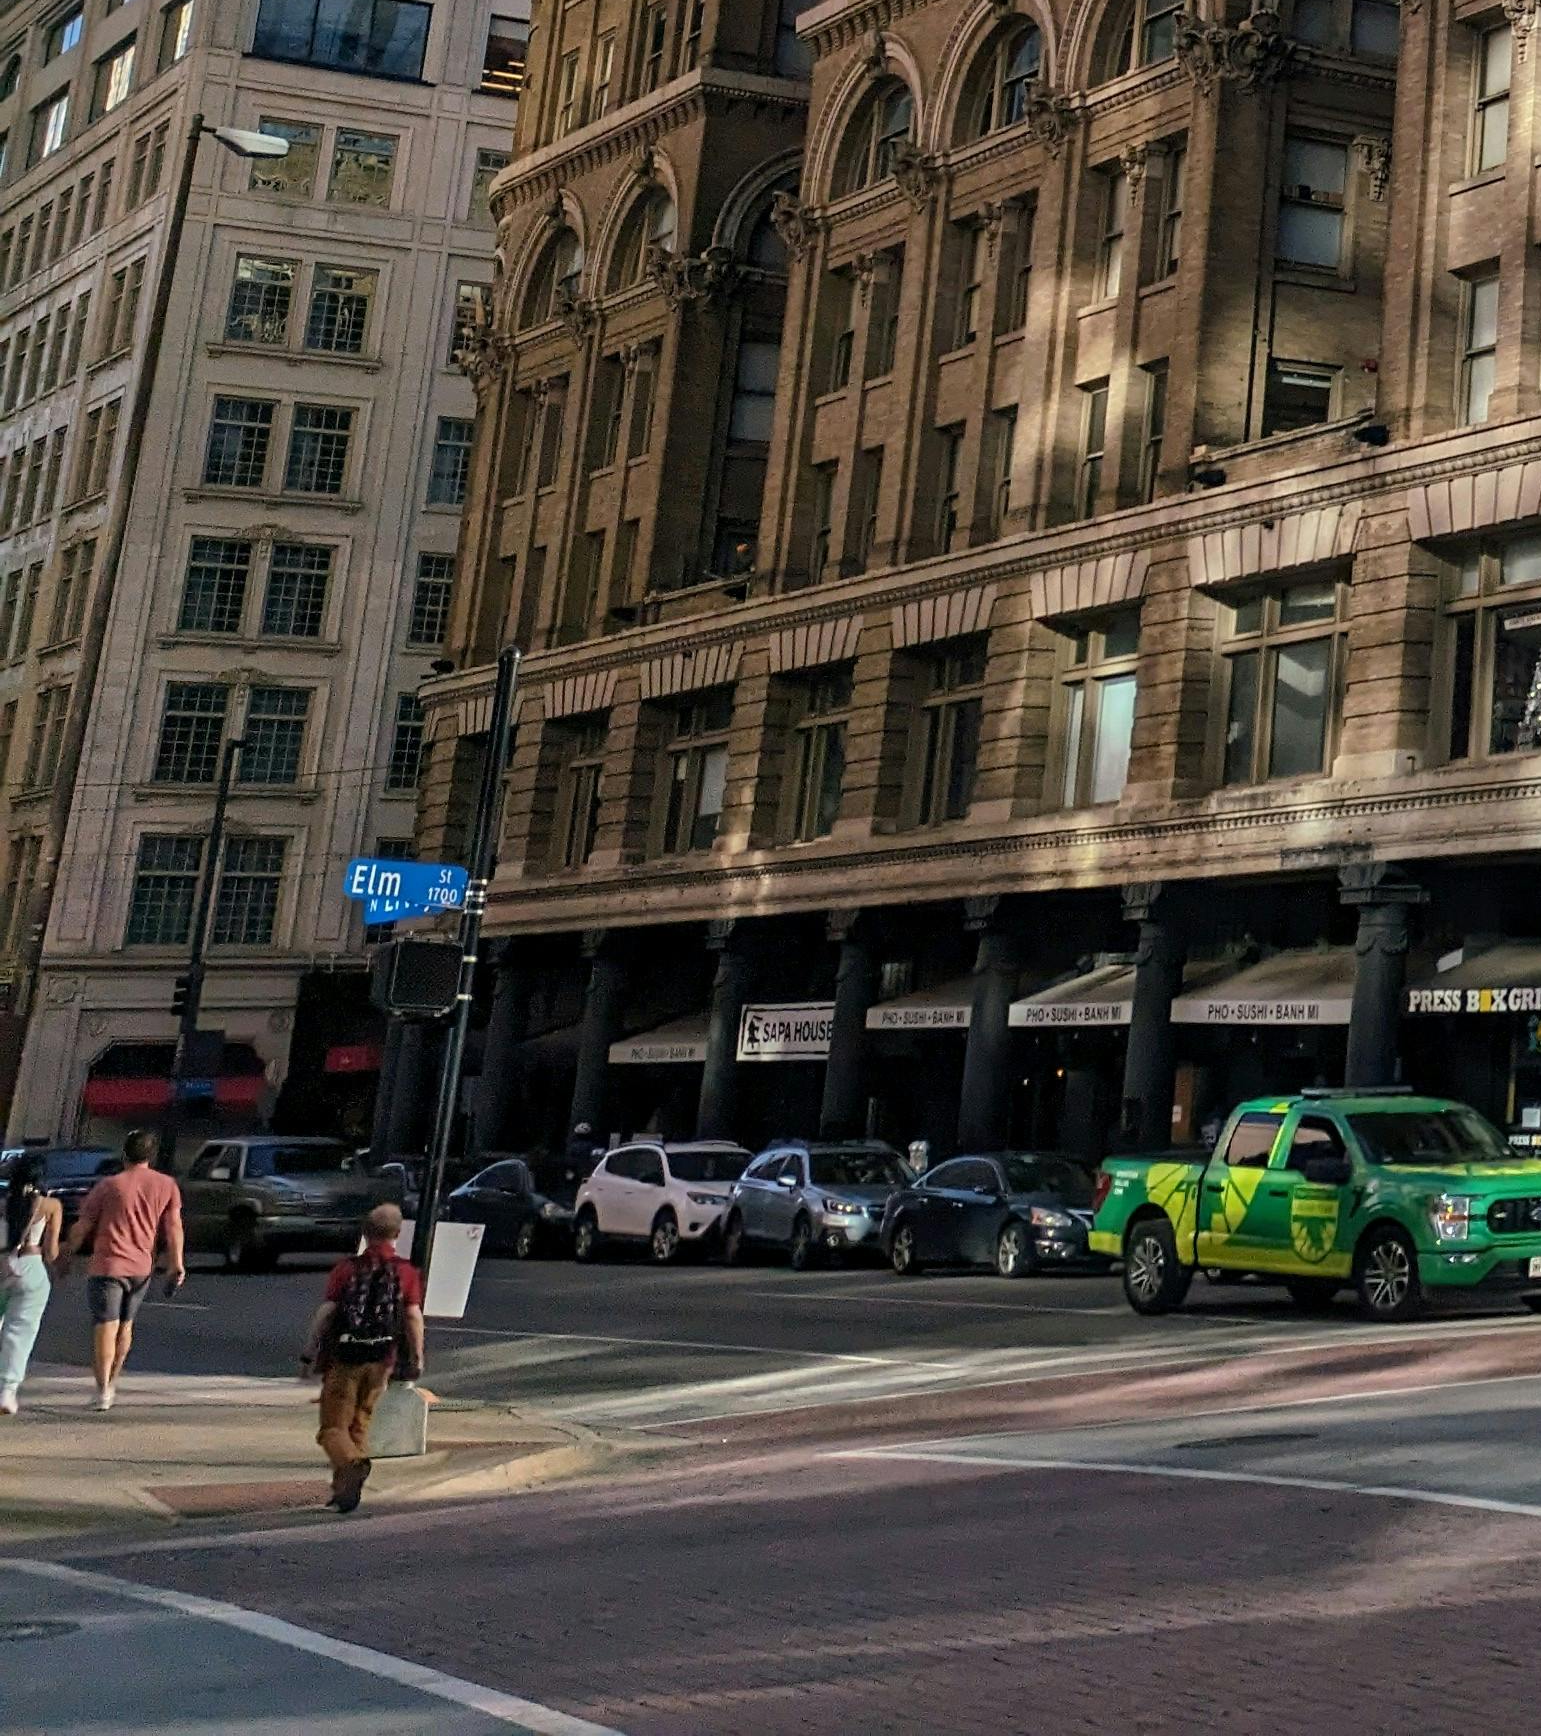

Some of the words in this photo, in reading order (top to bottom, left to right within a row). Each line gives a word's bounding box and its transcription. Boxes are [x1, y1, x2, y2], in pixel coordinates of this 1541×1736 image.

[352, 864, 401, 896] Elm
[439, 869, 452, 884] St
[428, 887, 457, 903] 1700
[1408, 989, 1462, 1012] PRESS
[902, 1010, 927, 1024] SUSHI
[1026, 1008, 1043, 1022] PHO
[1051, 1007, 1077, 1021] SUSHI
[1084, 1006, 1109, 1021] BANH
[1208, 1004, 1229, 1020] PHO
[1237, 1004, 1267, 1019] SUSHI
[1276, 1004, 1304, 1019] BANH
[1307, 1004, 1319, 1019] MI
[763, 1021, 792, 1042] SAPA
[794, 1020, 832, 1041] HOUSE
